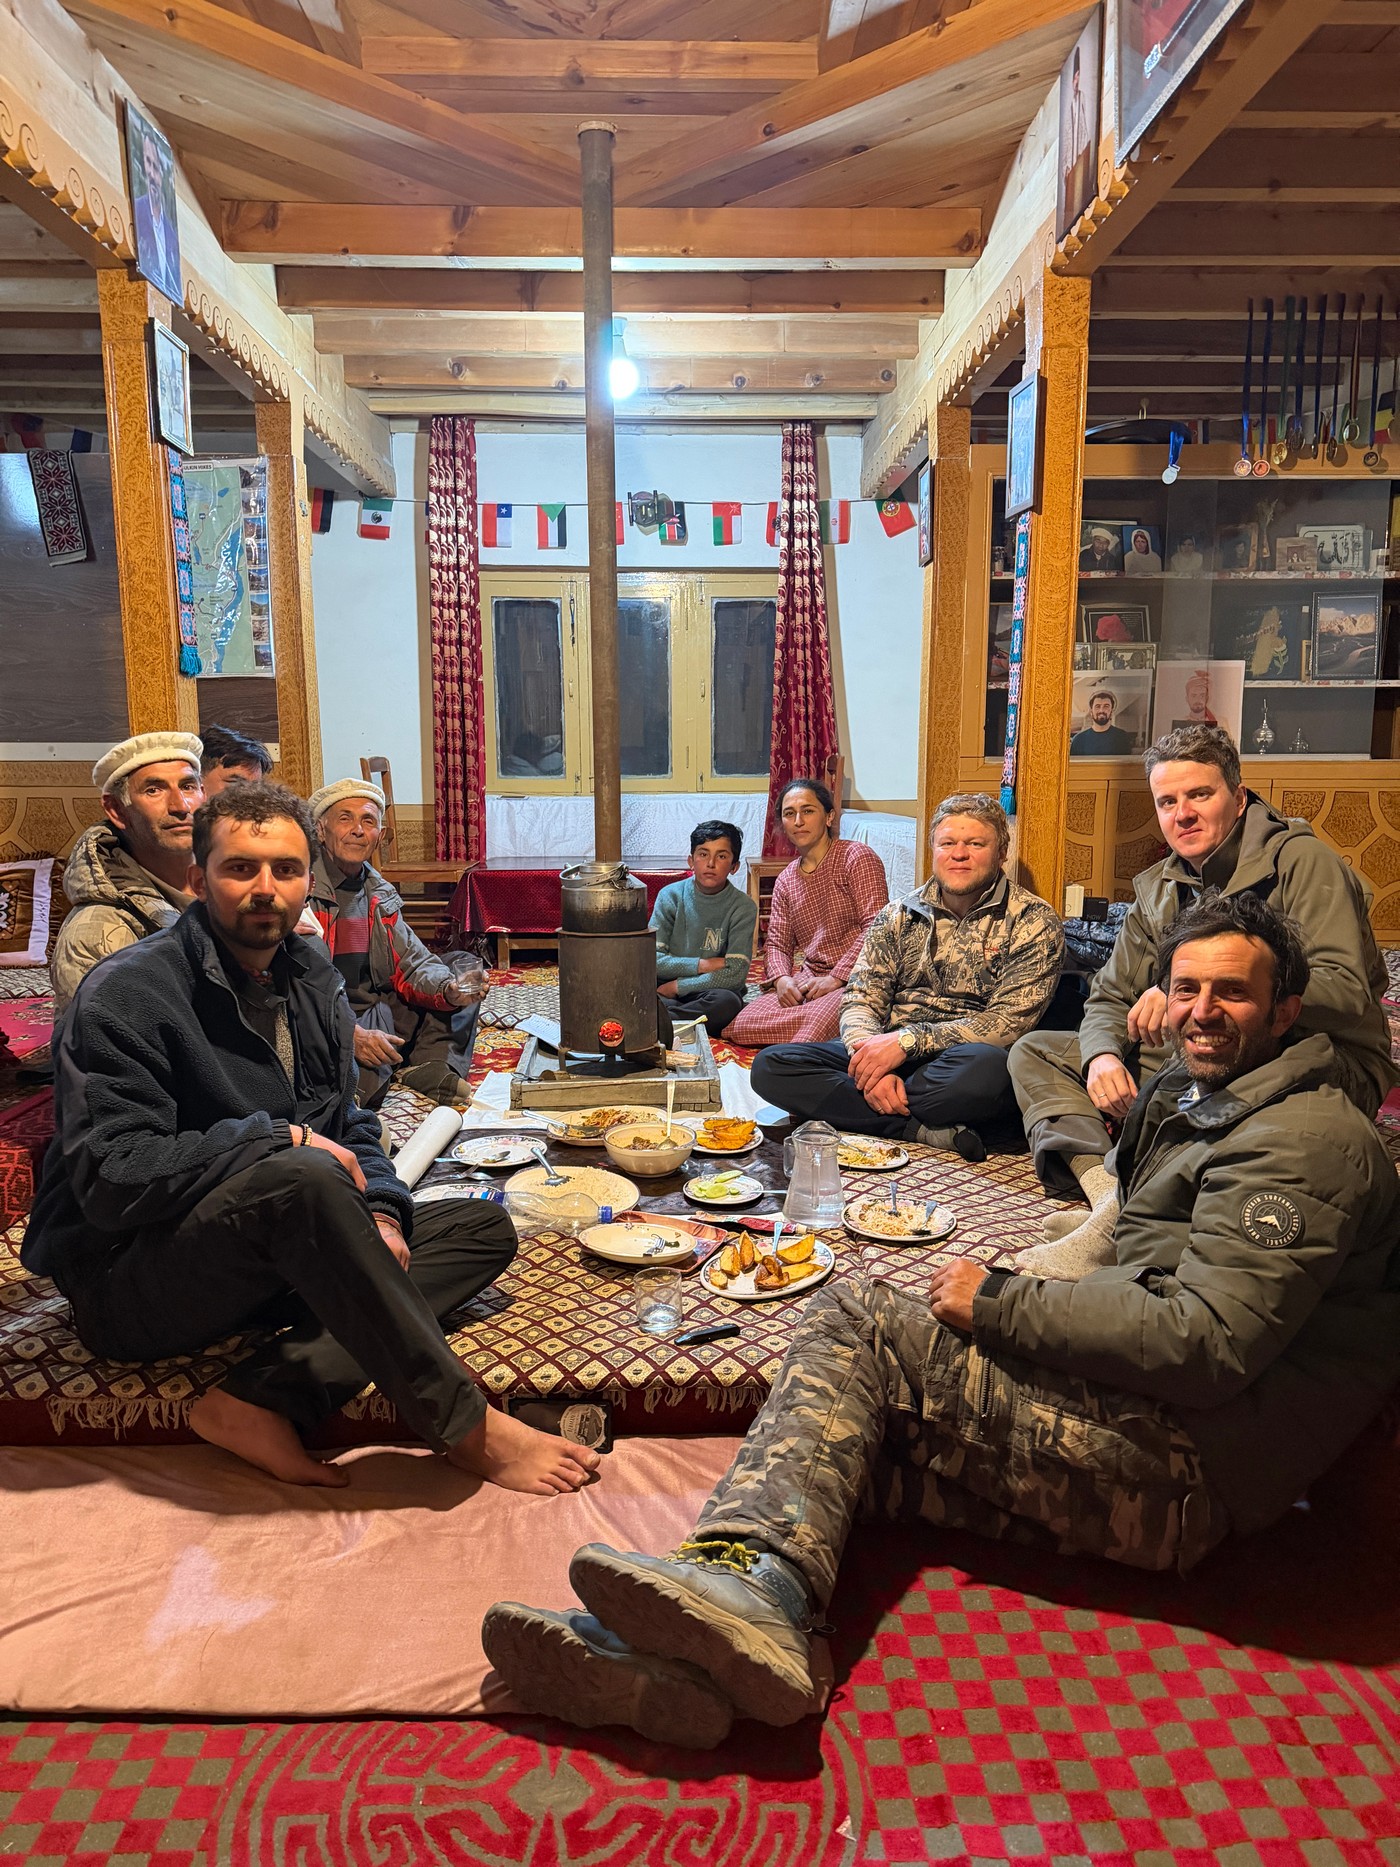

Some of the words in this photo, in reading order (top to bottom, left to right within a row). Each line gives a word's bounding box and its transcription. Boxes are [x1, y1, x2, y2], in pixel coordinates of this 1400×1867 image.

[700, 927, 724, 952] N
[1244, 1197, 1262, 1226] MOUNTAIN
[1264, 1194, 1296, 1213] SURFANIC
[1266, 1232, 1294, 1246] APPAREL
